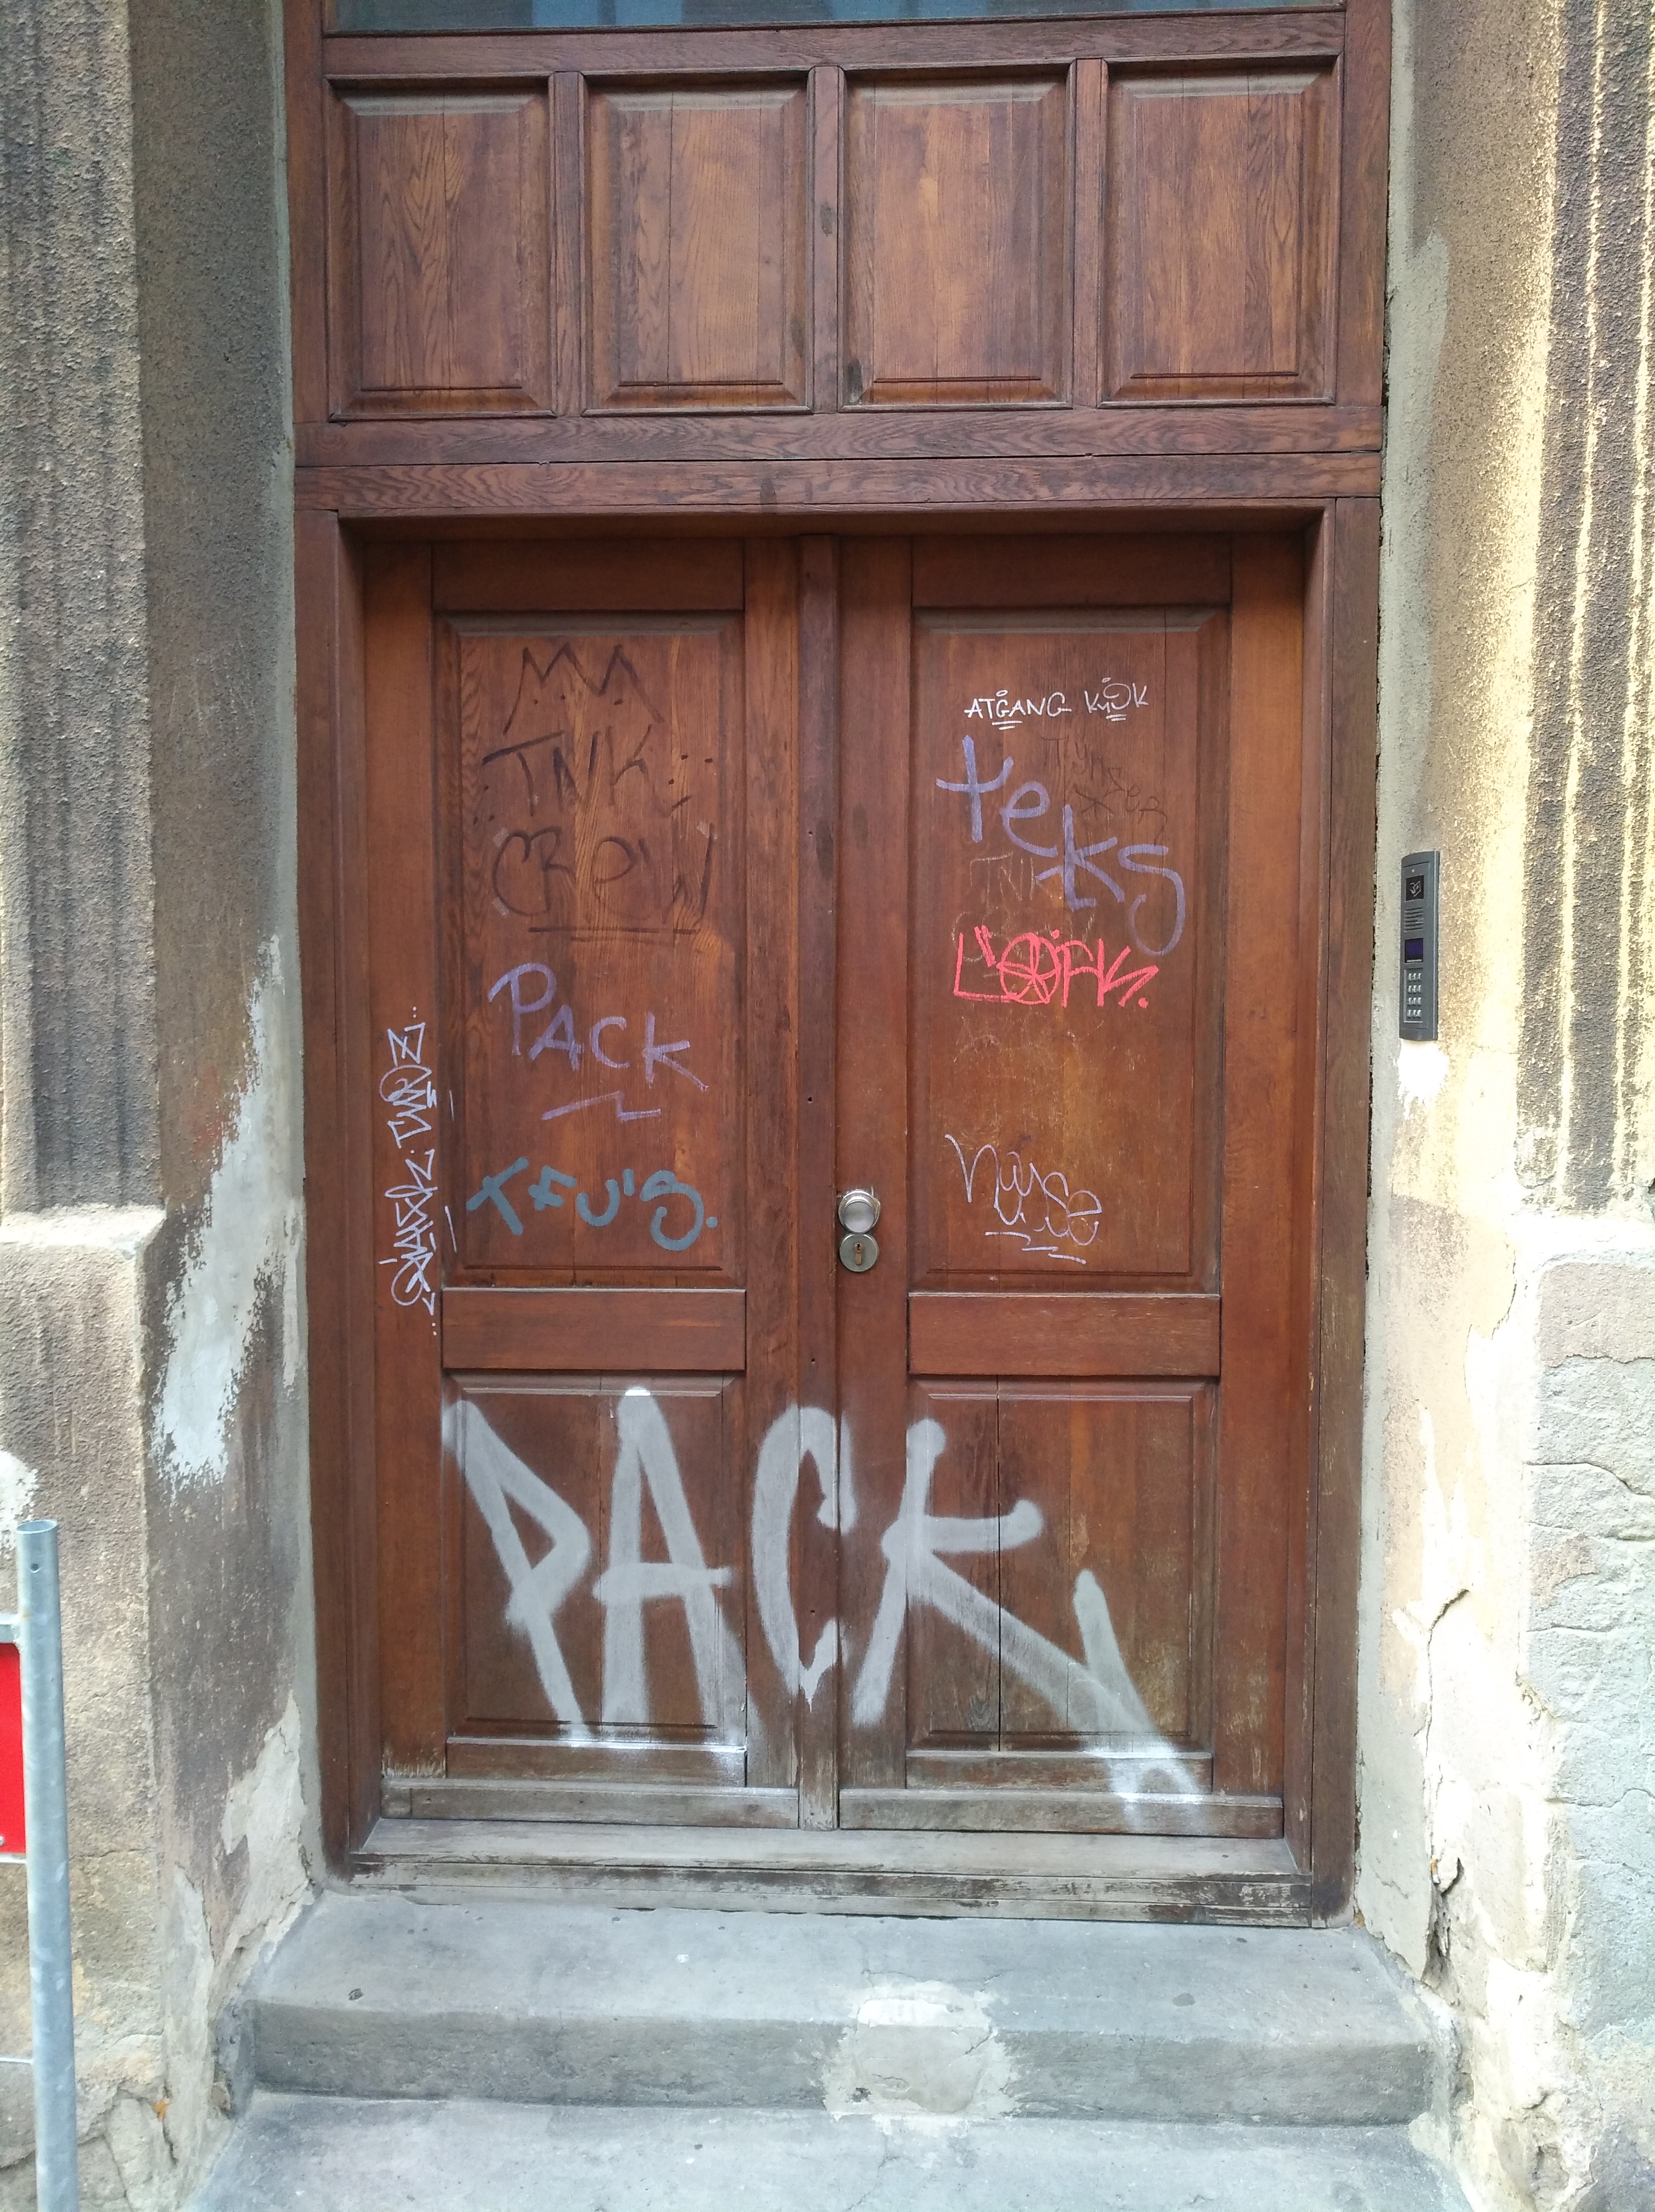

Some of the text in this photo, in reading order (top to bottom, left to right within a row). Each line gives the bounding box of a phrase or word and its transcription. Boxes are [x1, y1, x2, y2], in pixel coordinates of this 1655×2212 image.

[964, 690, 1073, 720] ATGANG
[488, 962, 710, 1092] PACK
[441, 1386, 1203, 1805] PACK
